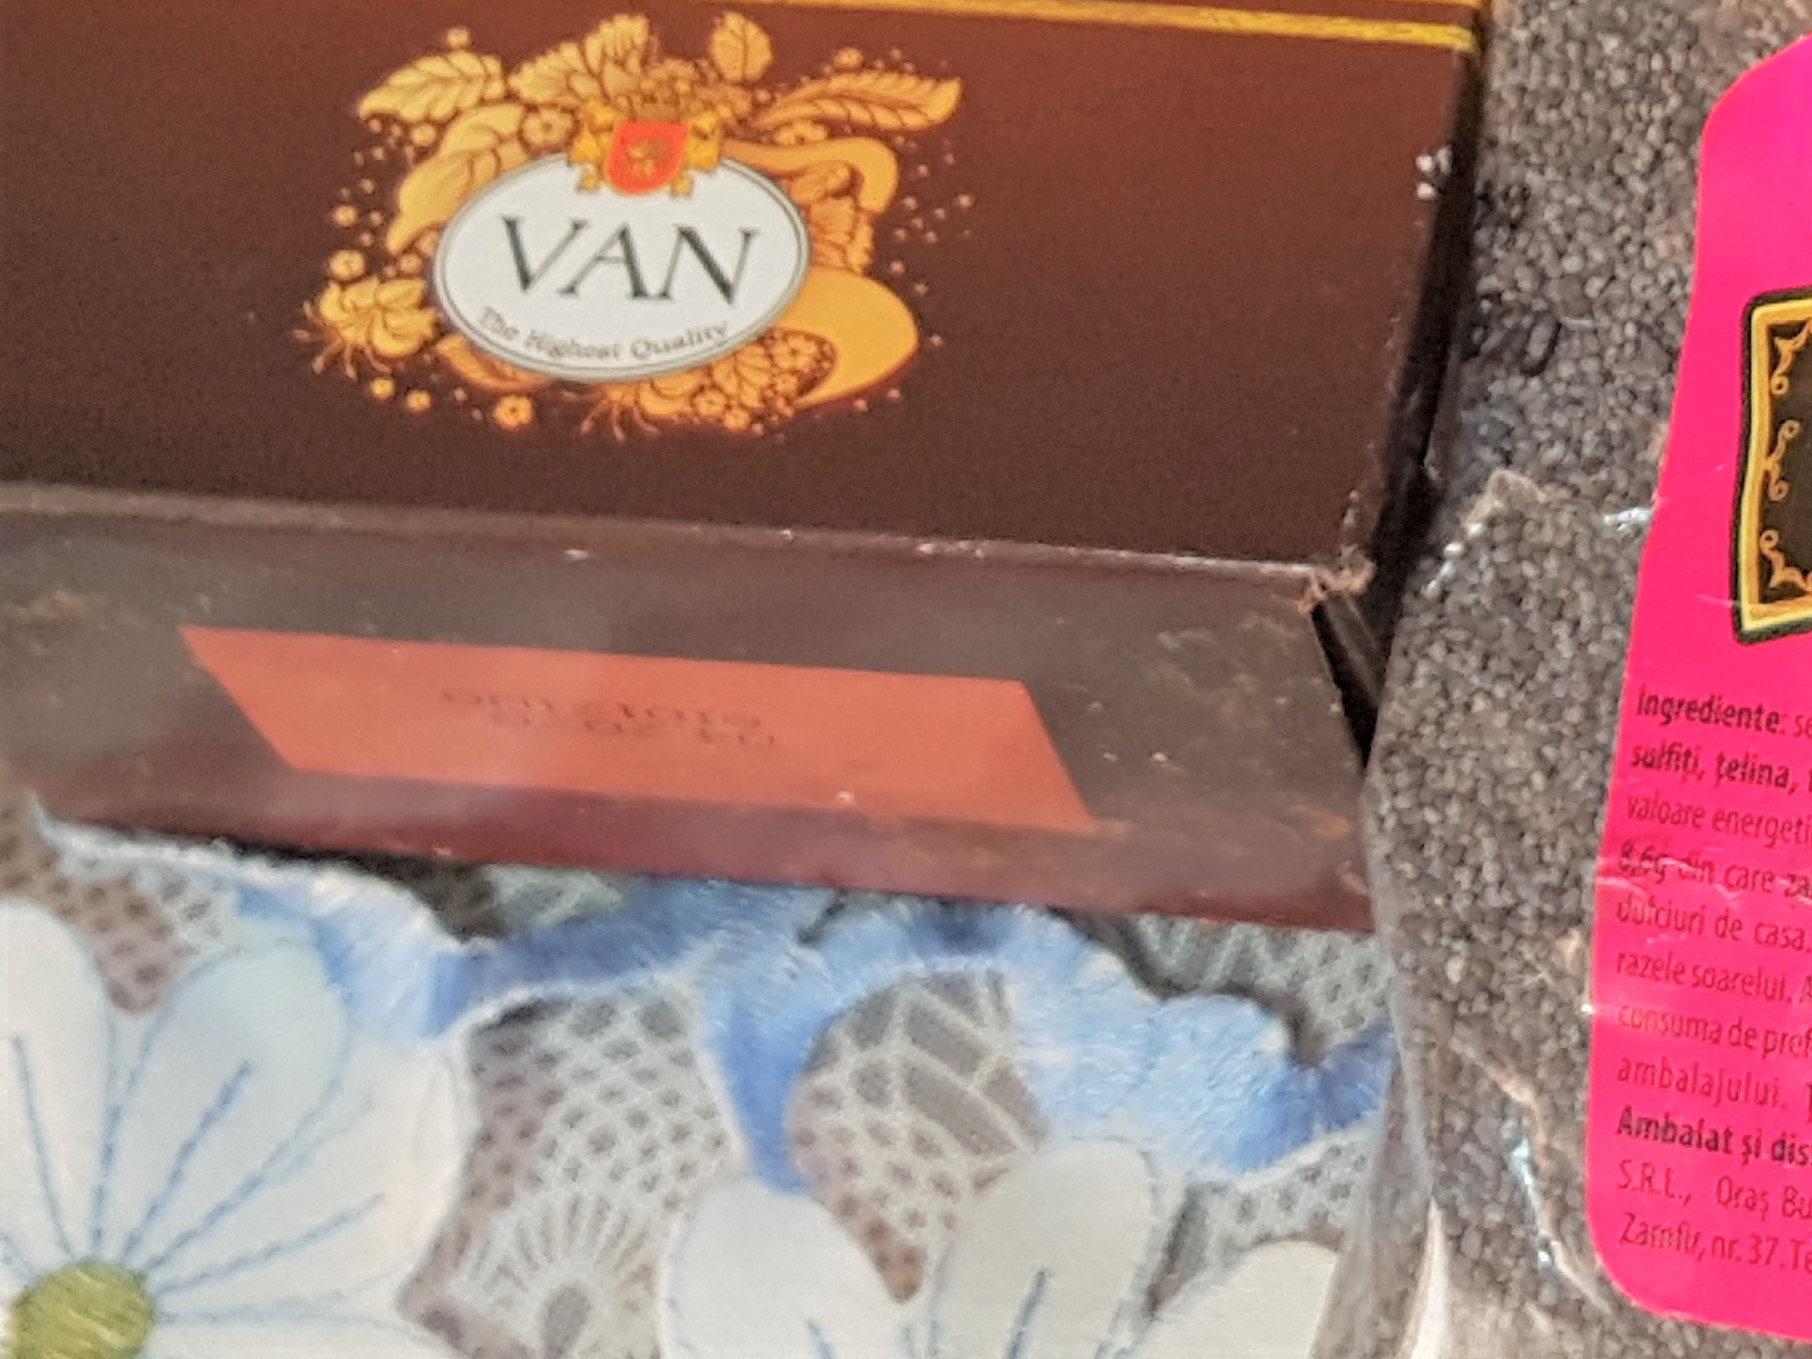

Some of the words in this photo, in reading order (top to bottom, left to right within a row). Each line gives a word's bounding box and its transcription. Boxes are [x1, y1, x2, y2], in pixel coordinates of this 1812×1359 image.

[500, 215, 760, 303] VAN
[480, 306, 518, 340] The
[629, 320, 727, 359] Quality
[1626, 797, 1705, 829] valoare
[1677, 854, 1714, 883] din
[1724, 864, 1775, 893] care
[1714, 914, 1743, 940] de
[1754, 922, 1810, 952] casa.
[1616, 952, 1685, 985] razele
[1691, 965, 1791, 1003] soarelui.
[1619, 1013, 1722, 1044] consuma
[1727, 1016, 1758, 1049] de
[1617, 1060, 1787, 1106] ambalajului.
[1615, 1104, 1734, 1154] Ambalat
[1740, 1127, 1762, 1166] și
[1716, 1174, 1769, 1221] Oraș
[1711, 1234, 1738, 1259] nr.
